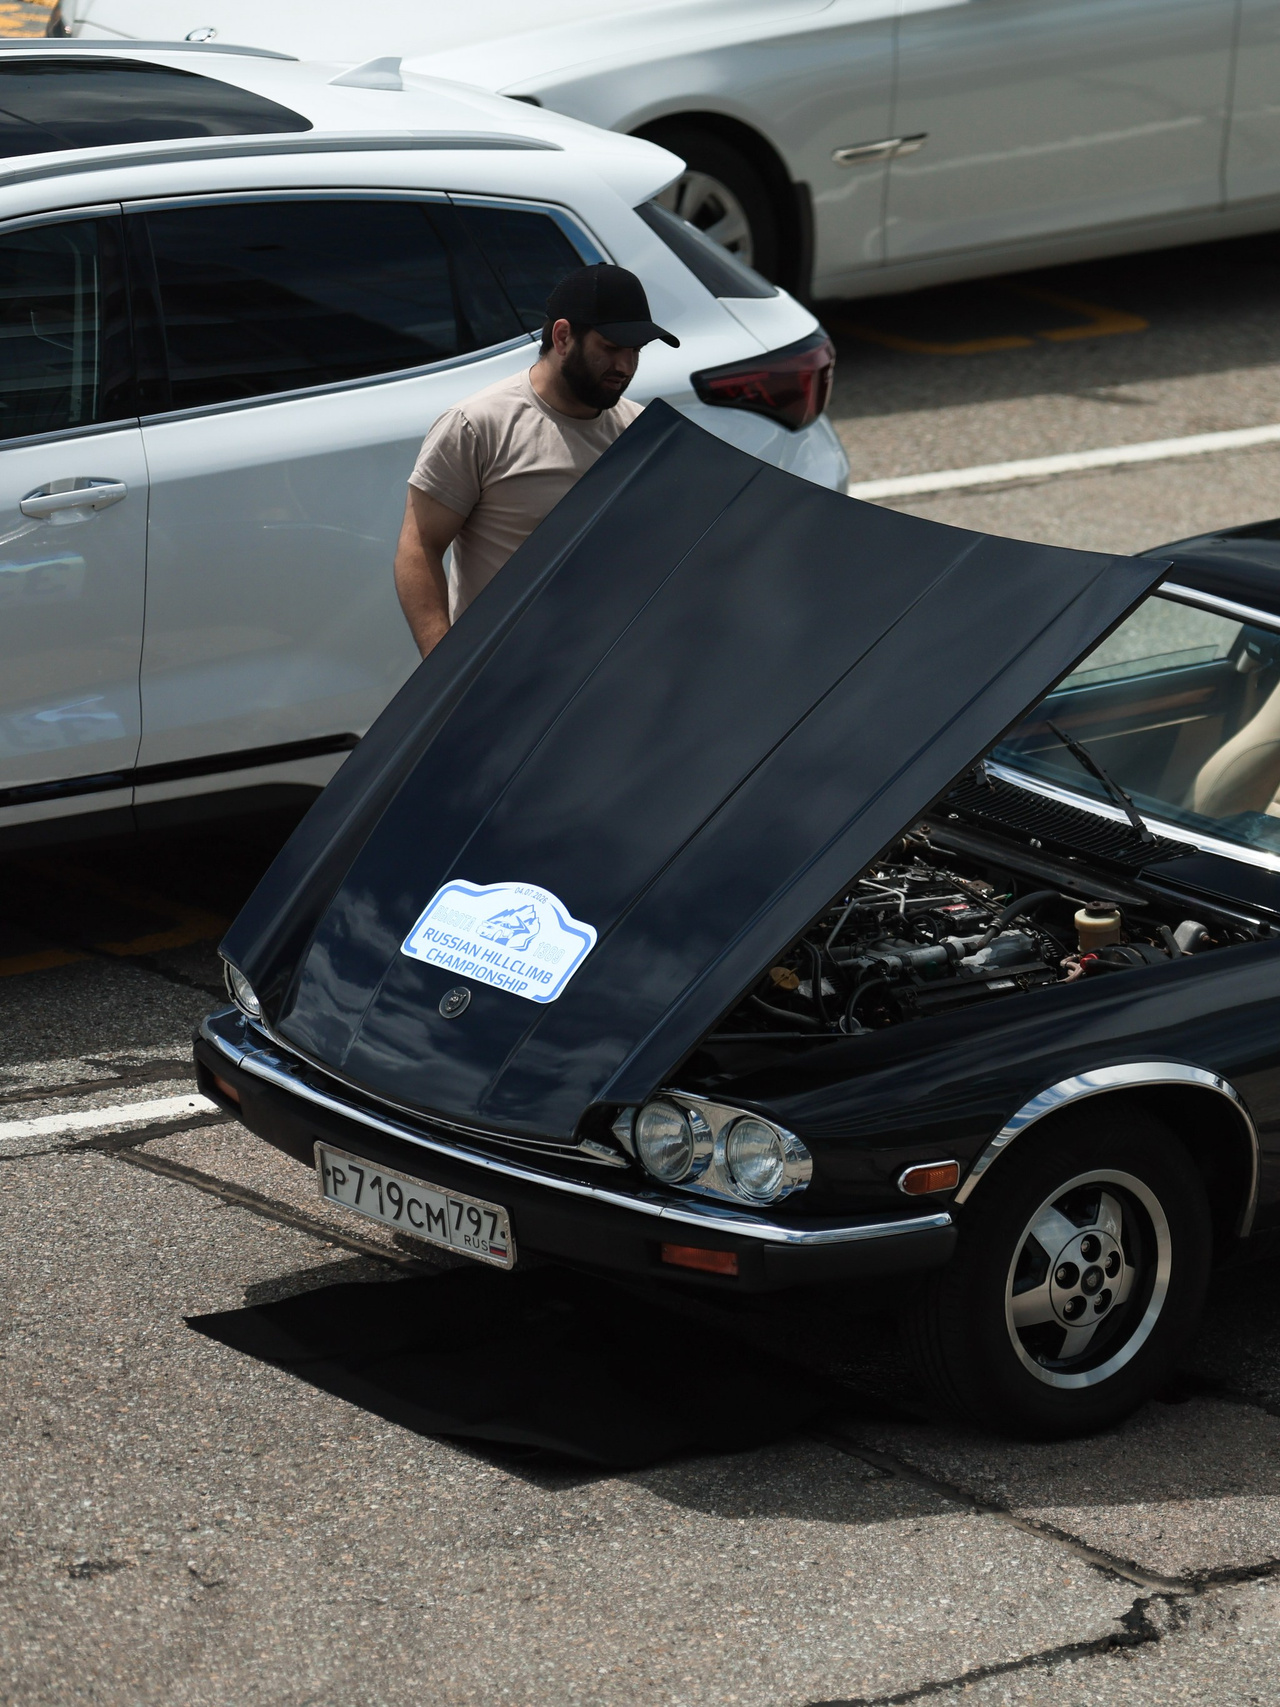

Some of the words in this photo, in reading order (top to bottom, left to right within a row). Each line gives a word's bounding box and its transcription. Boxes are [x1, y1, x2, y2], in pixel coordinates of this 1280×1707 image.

[514, 886, 549, 905] 04.07.2026
[432, 904, 477, 933] ВЫСОТА
[422, 927, 483, 957] RUSSIAN
[480, 948, 554, 985] HILLCLIMB
[426, 947, 529, 993] CHAMPIONSHIP
[450, 1201, 498, 1241] 797
[464, 1234, 489, 1251] RUS
